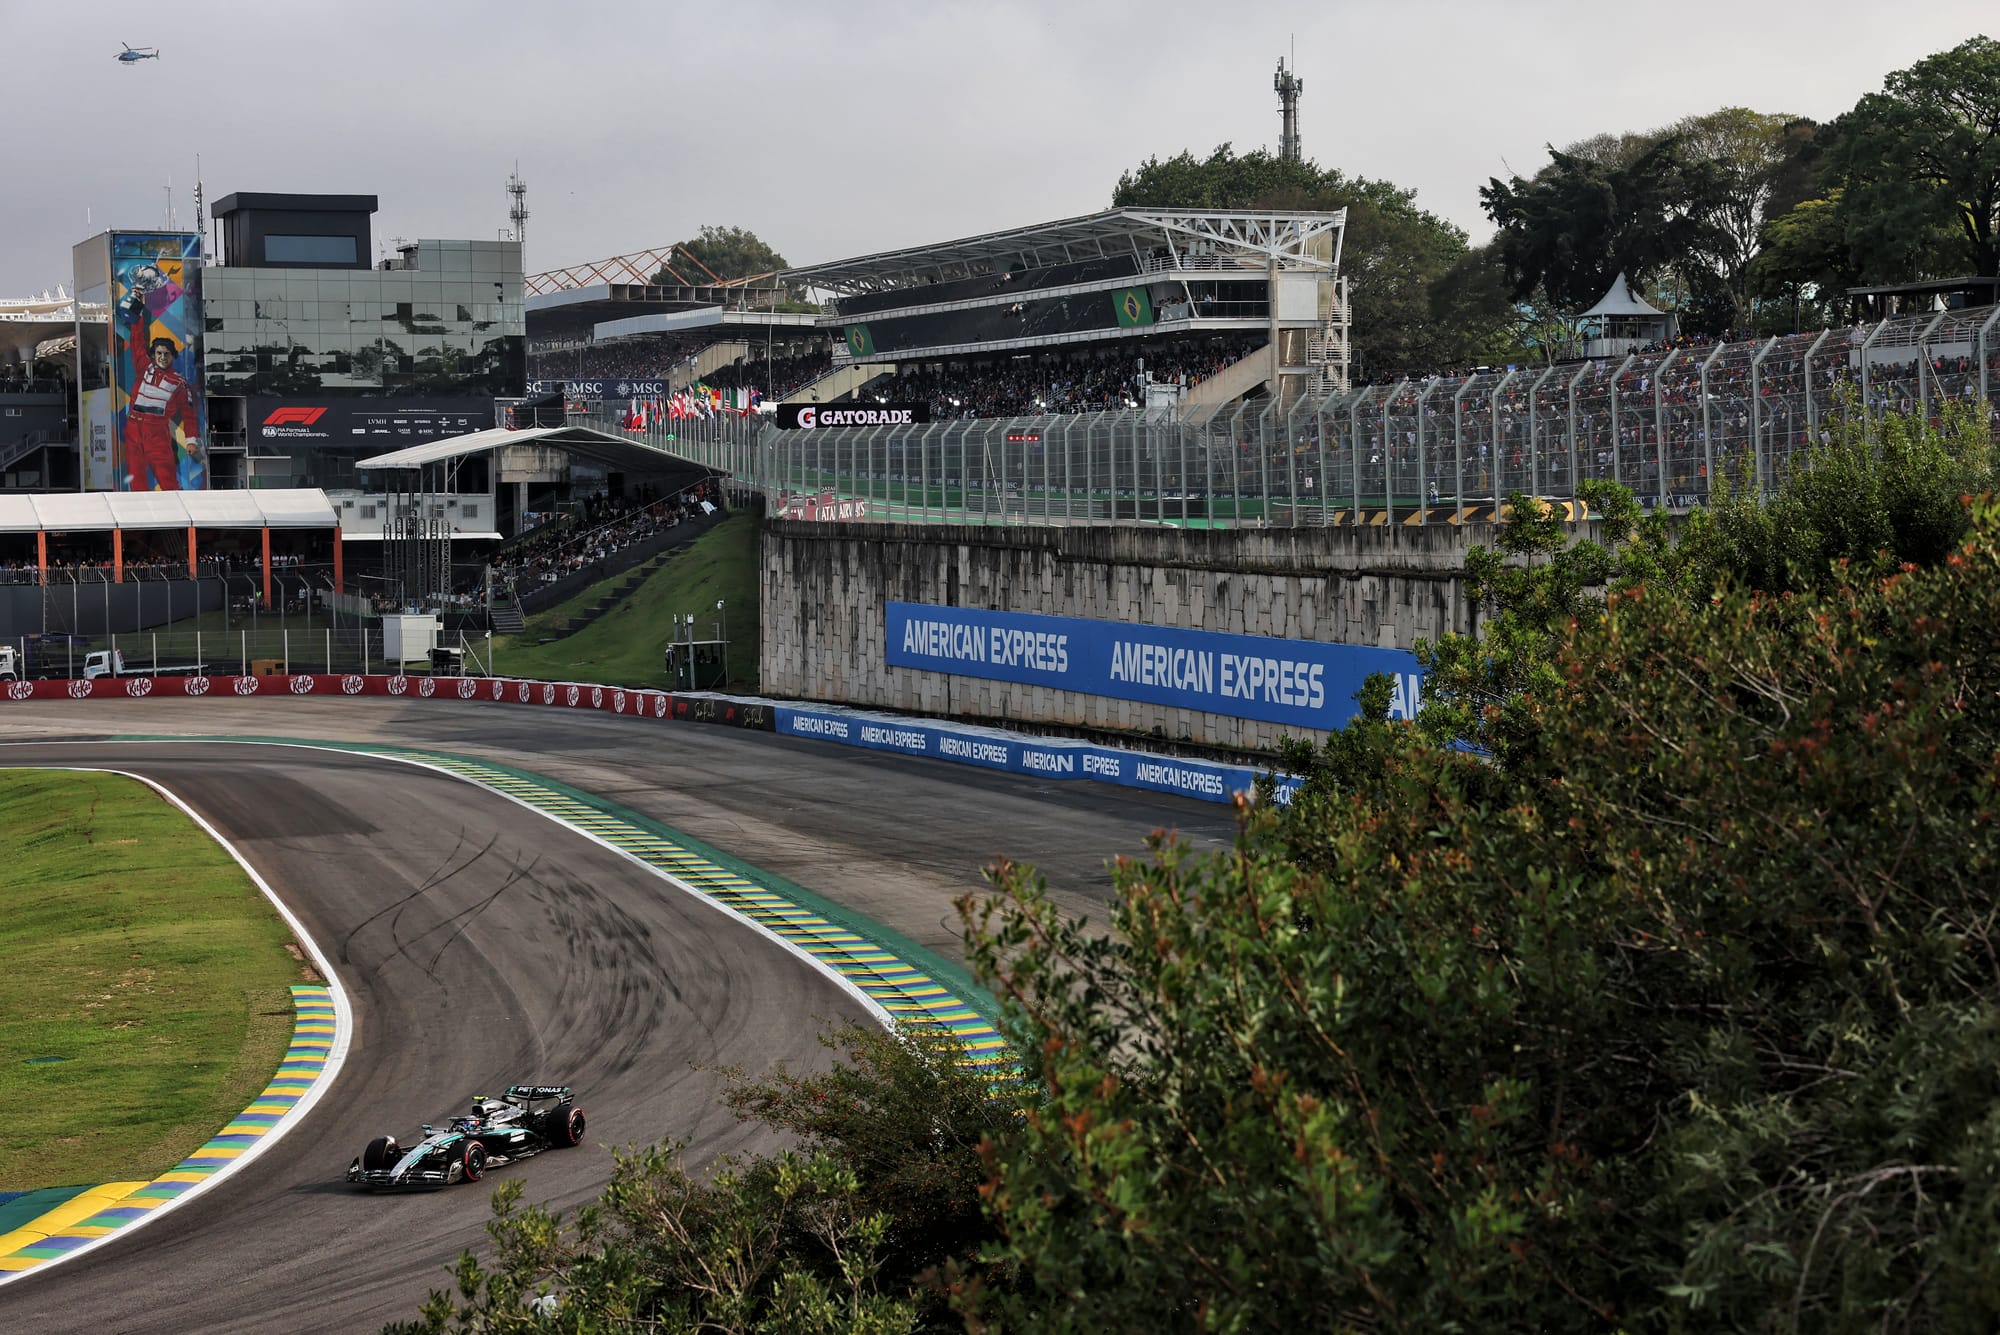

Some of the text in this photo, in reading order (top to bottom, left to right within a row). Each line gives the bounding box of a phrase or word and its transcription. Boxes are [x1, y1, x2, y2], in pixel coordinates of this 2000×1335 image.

[572, 383, 602, 393] MSC
[632, 383, 662, 393] MSC
[820, 410, 912, 424] GATORADE
[903, 619, 1068, 673] AMERICAN EXPRESS
[290, 675, 314, 693] KitKat
[342, 675, 363, 694] KitKat
[387, 675, 407, 694] KitKat
[1110, 641, 1213, 694] AMERICAN
[1220, 653, 1325, 709] EXPRESS
[10, 681, 33, 699] KitKat
[69, 680, 92, 698] KitKat
[127, 678, 152, 697] KitKat
[186, 677, 209, 696] KitKat
[234, 676, 258, 695] KitKat
[793, 716, 848, 738] AMERICAN EXPRESS
[861, 726, 926, 750] AMERICAN EXPRESS
[939, 737, 1007, 764] AMERICAN EXPRESS
[1022, 750, 1073, 772] AMERICAN
[1136, 763, 1223, 795] AMERICAN EXPRESS
